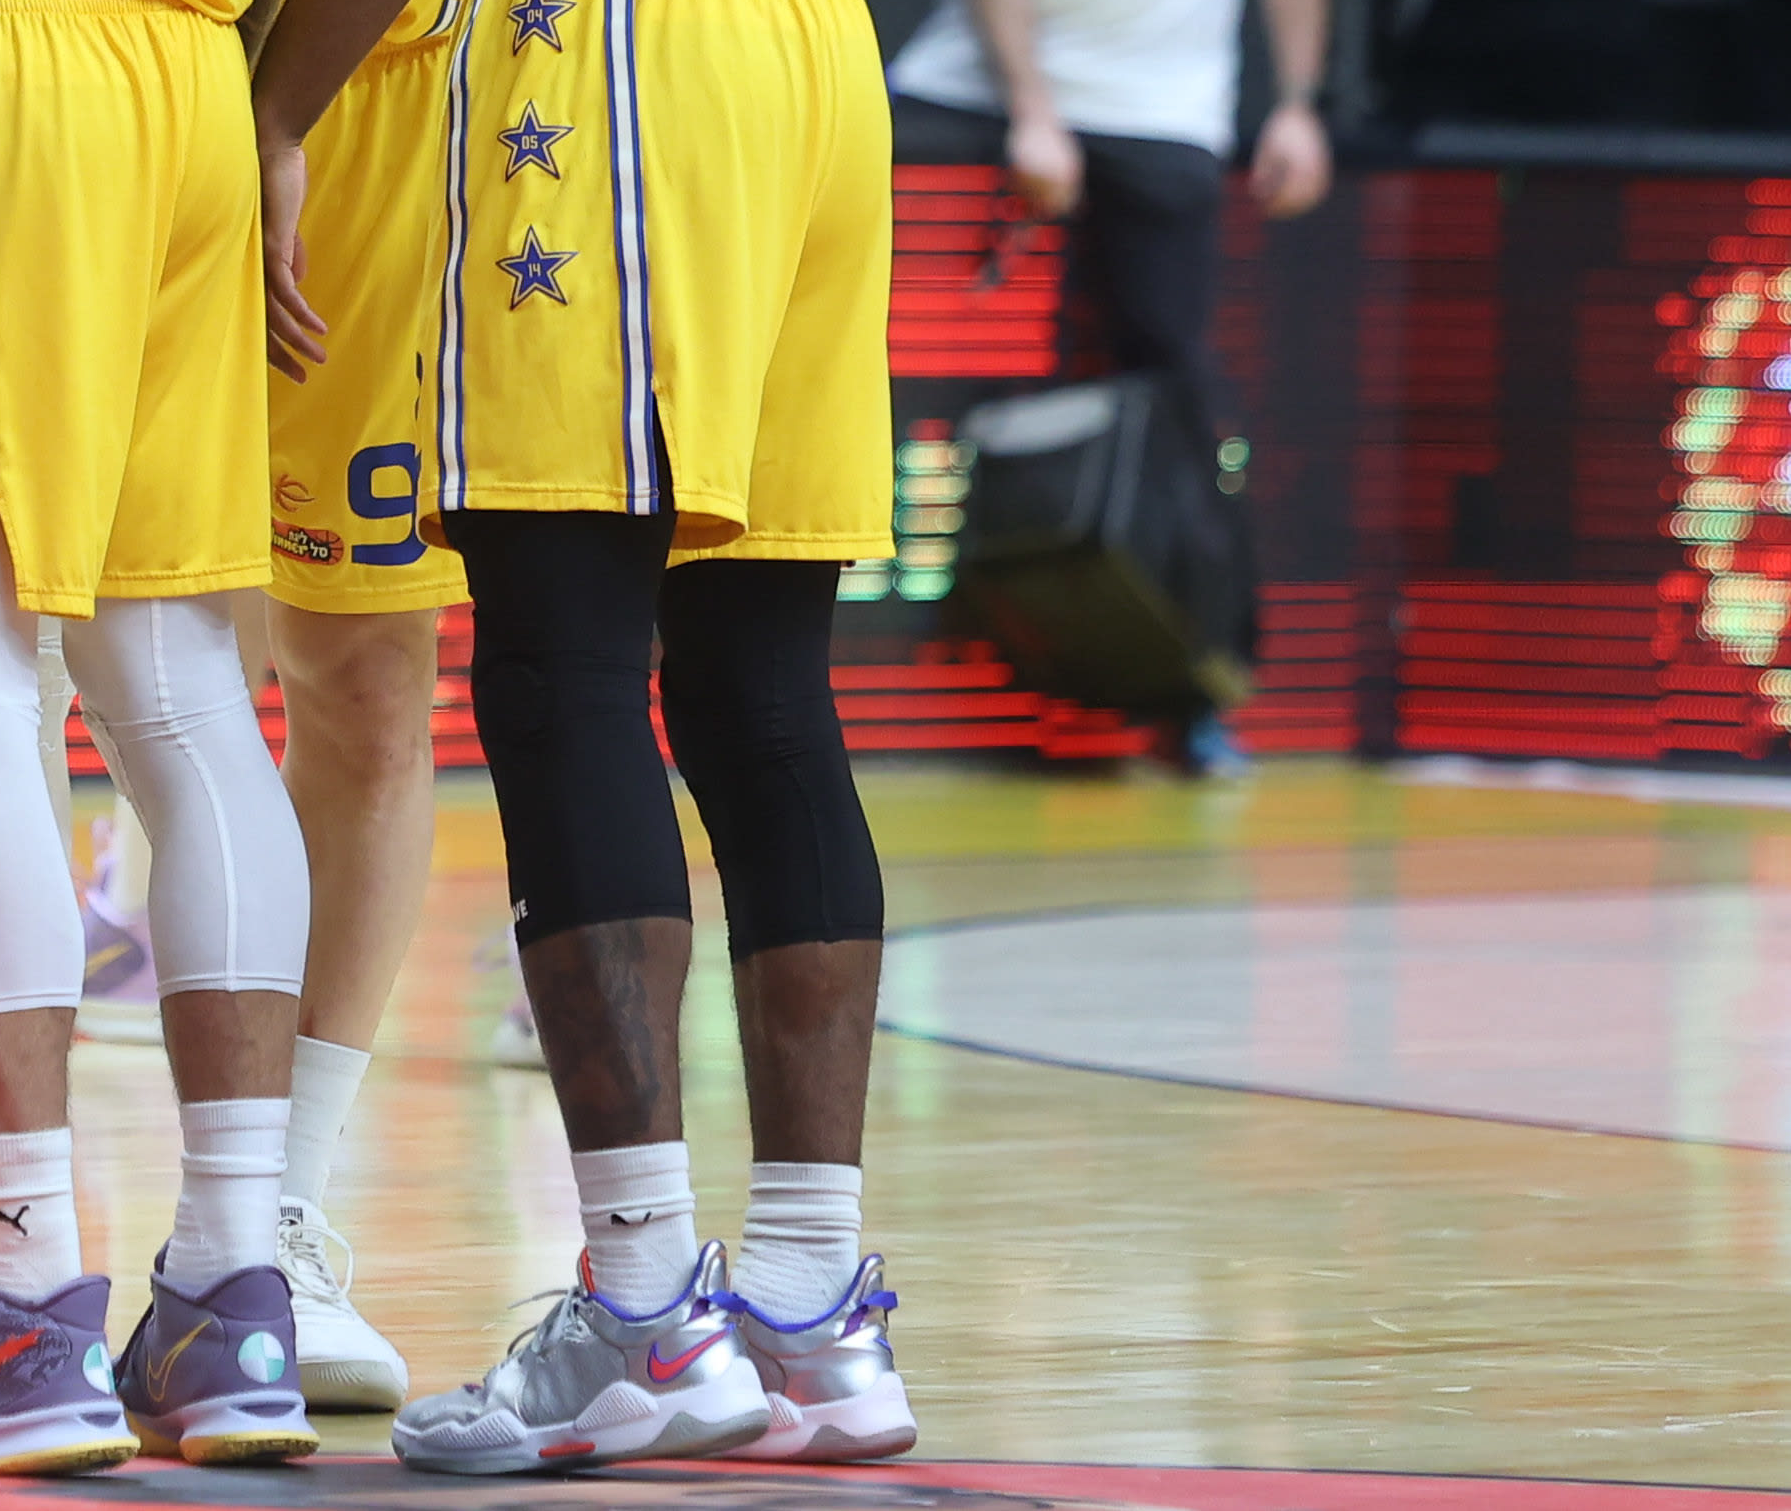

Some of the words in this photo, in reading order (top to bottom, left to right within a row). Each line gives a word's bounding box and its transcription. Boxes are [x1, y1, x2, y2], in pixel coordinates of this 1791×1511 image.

[526, 8, 544, 25] 04
[520, 134, 539, 151] 05
[526, 262, 542, 278] 14
[346, 442, 428, 566] 9
